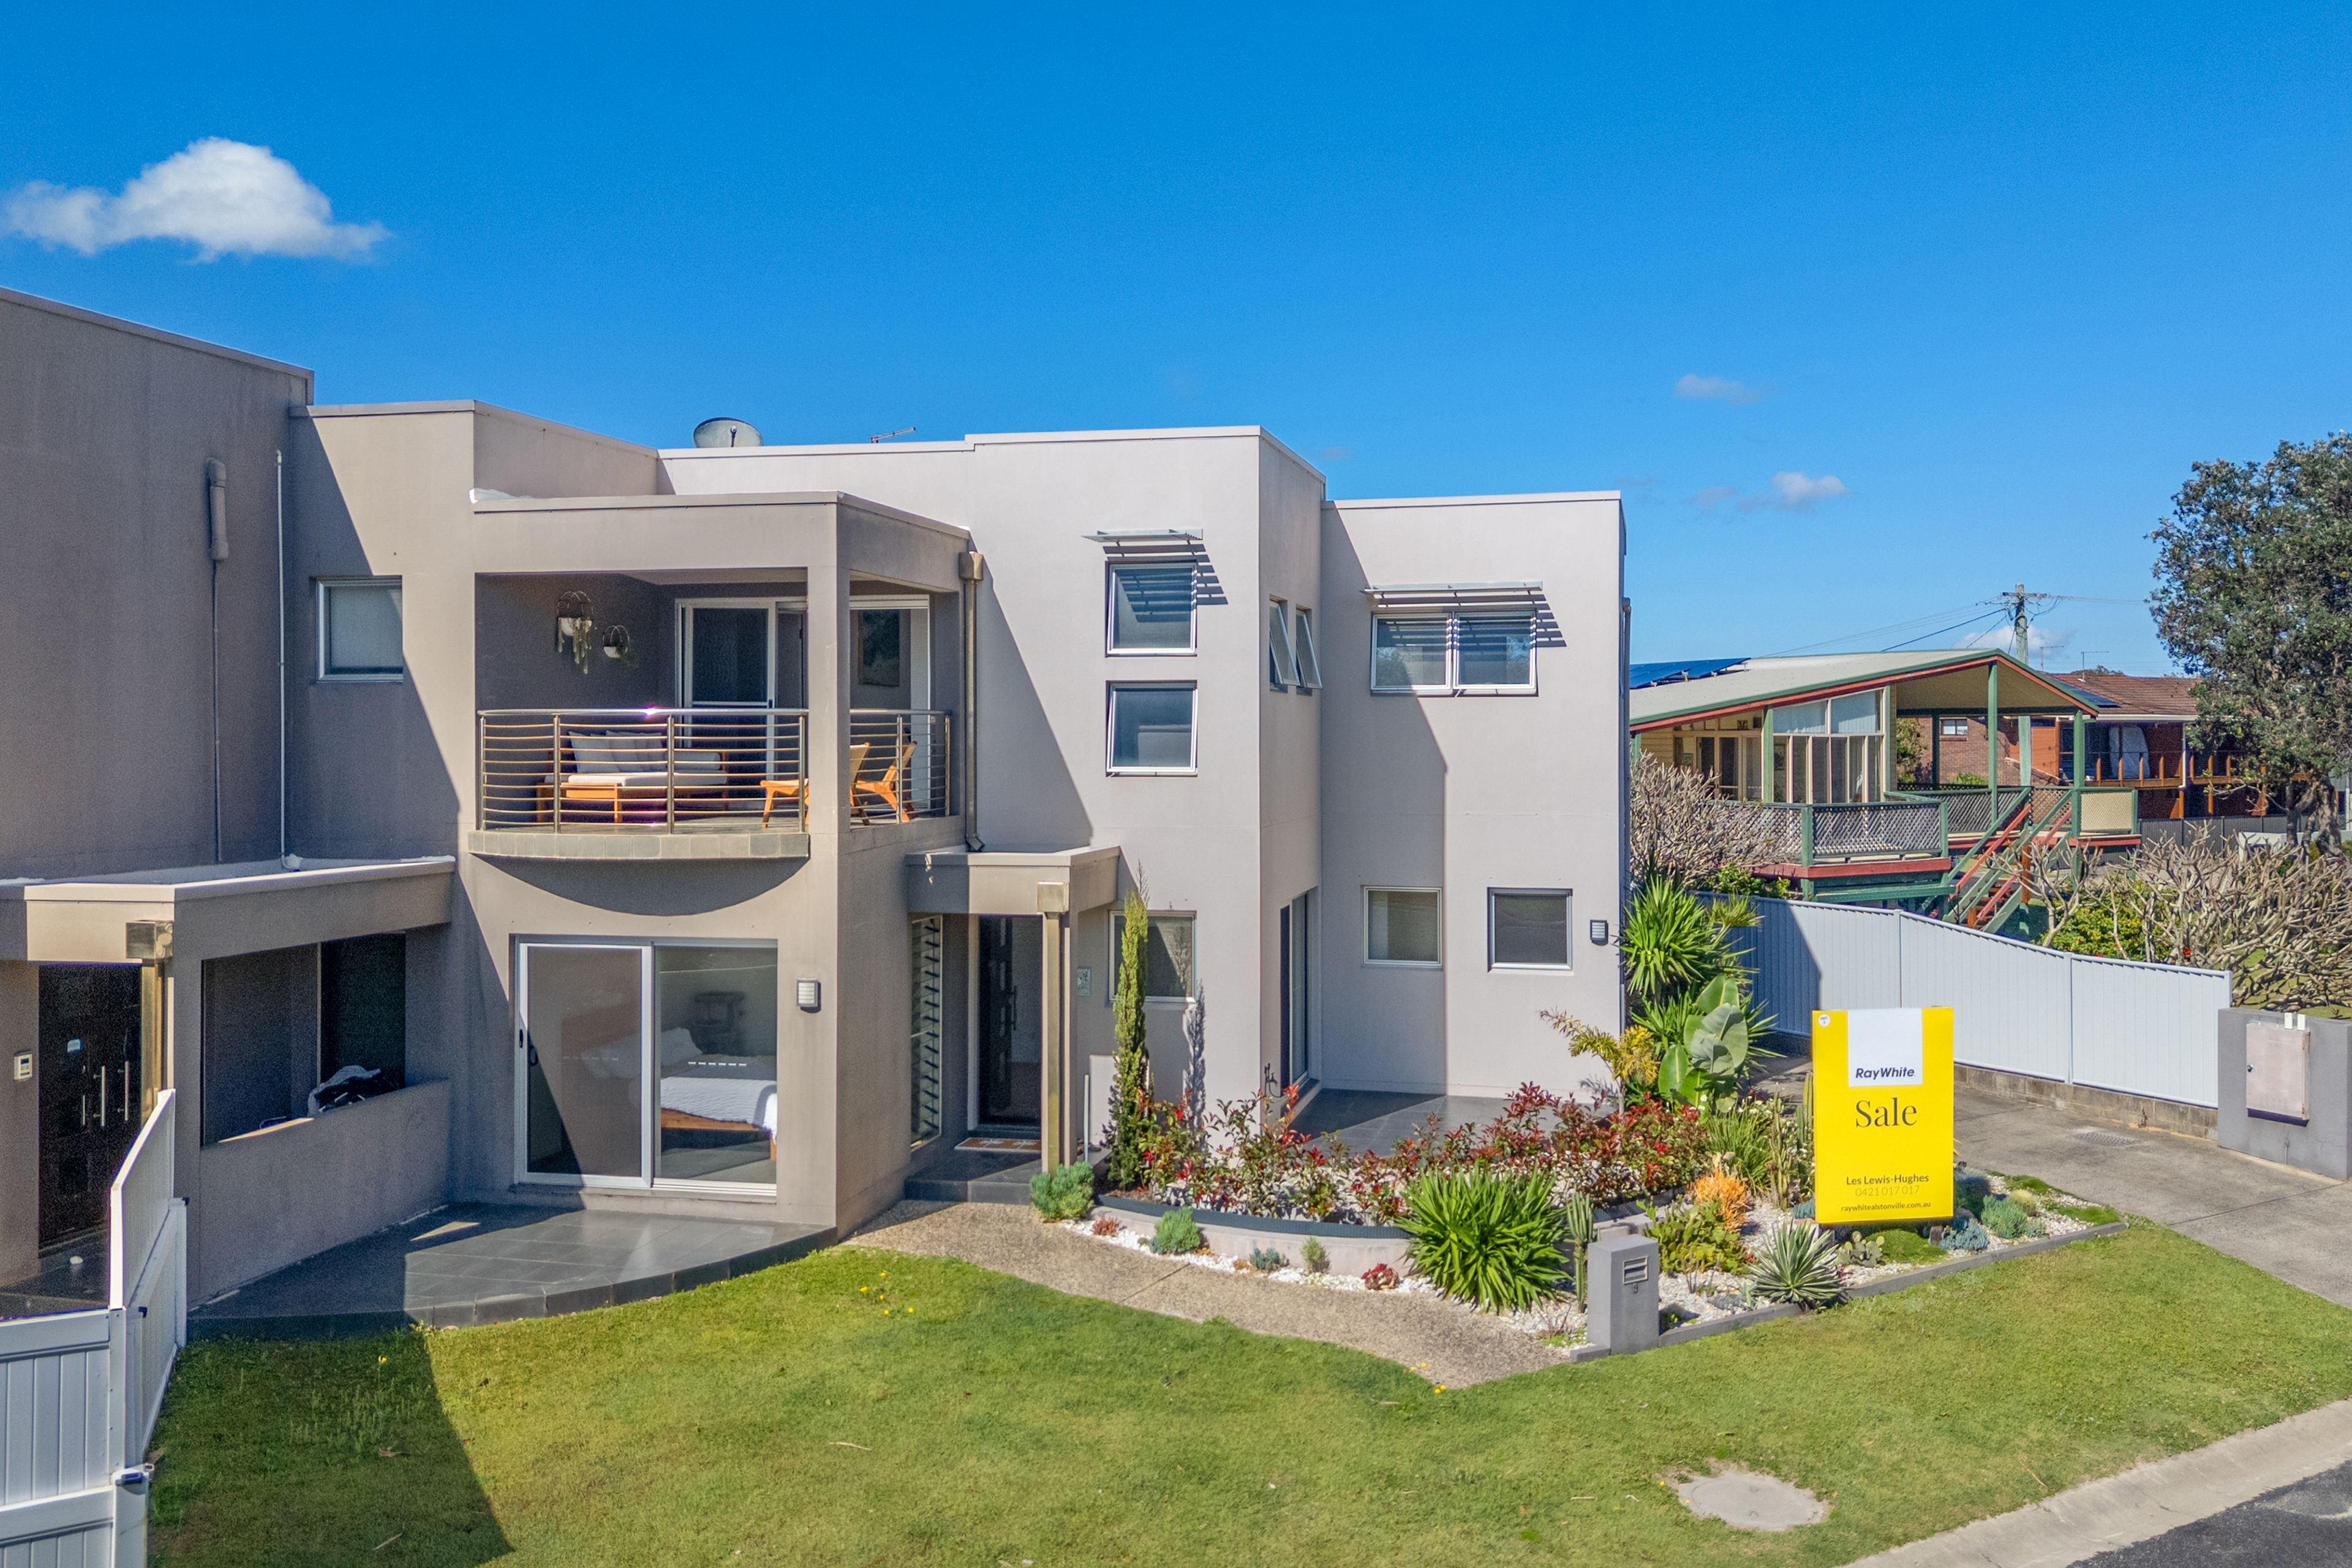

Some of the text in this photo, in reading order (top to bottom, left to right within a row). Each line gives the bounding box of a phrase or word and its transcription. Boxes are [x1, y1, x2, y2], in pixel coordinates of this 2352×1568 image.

[1856, 1097, 1917, 1128] Sale
[1846, 1174, 1929, 1185] Les Lewis-Hughes
[1855, 1185, 1920, 1197] 0421 017 017
[1841, 1202, 1931, 1213] raywhitealstonville.com.au
